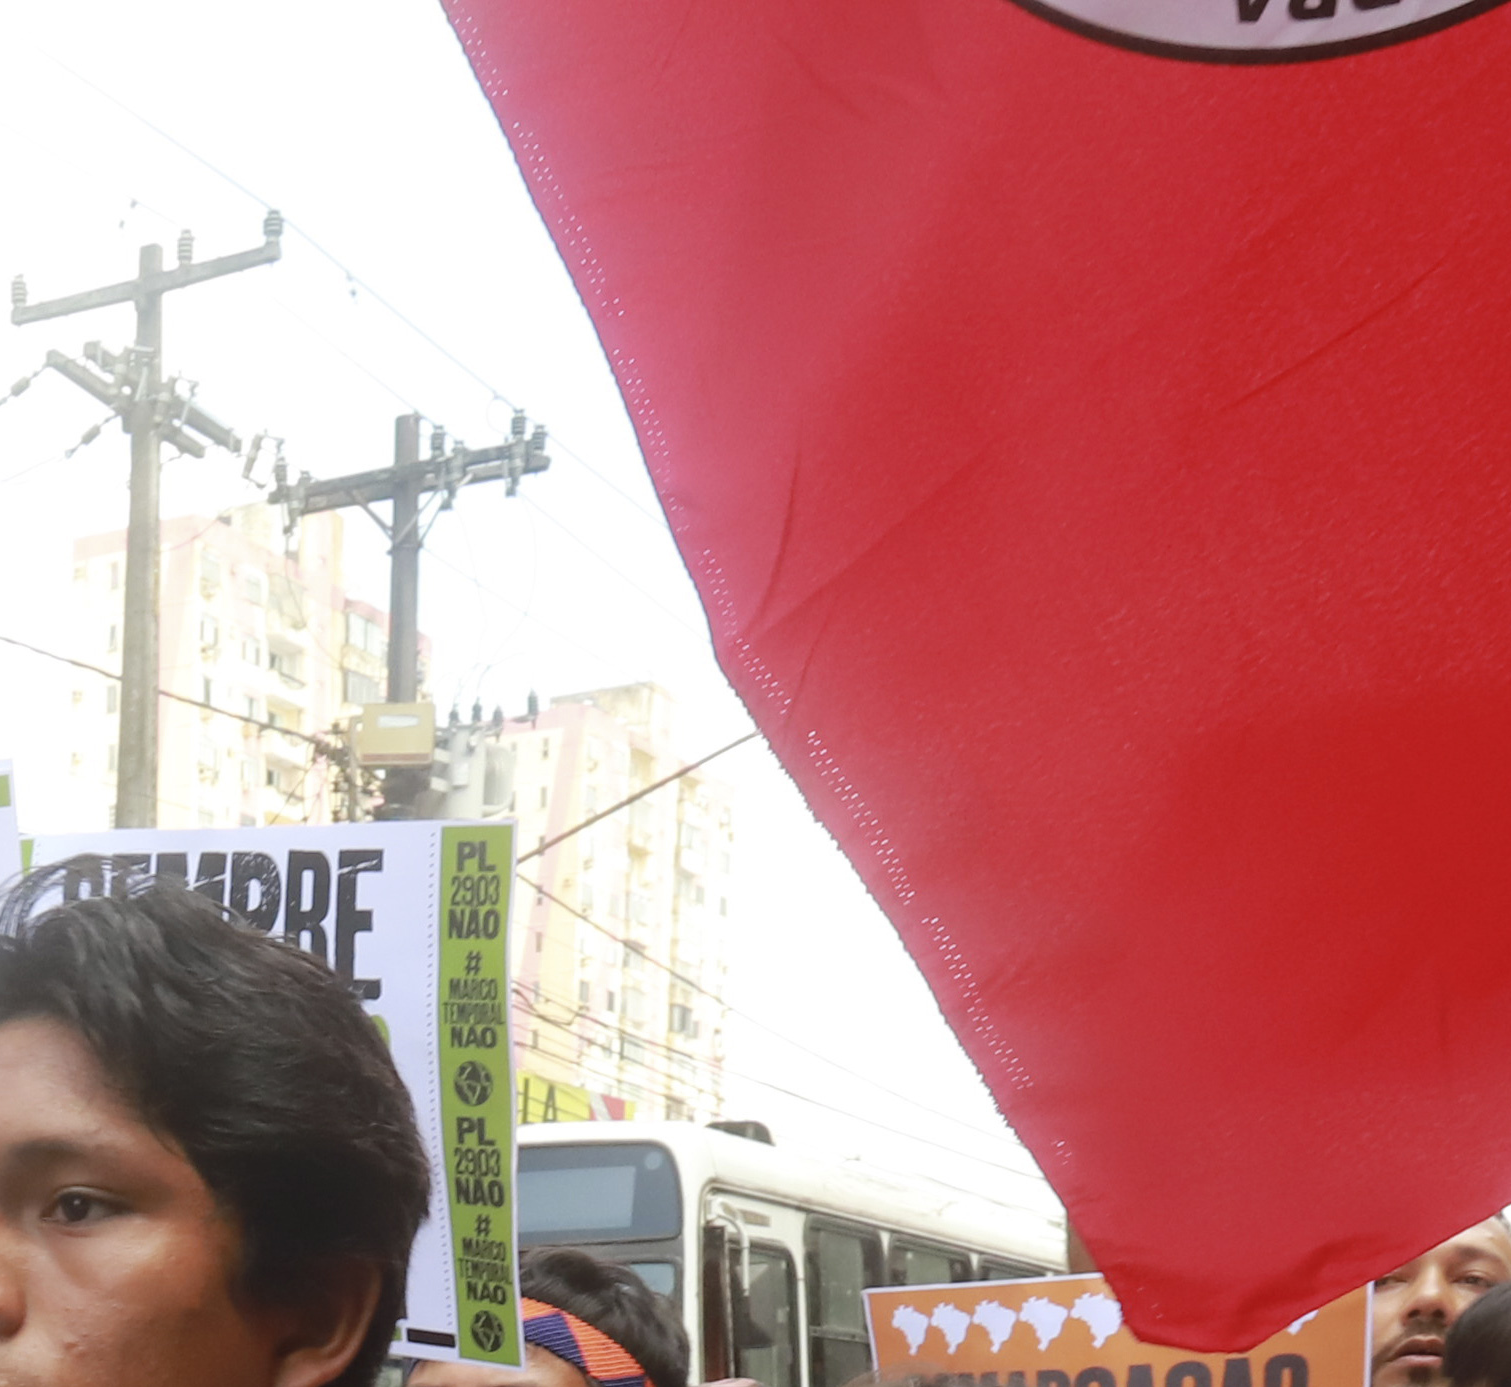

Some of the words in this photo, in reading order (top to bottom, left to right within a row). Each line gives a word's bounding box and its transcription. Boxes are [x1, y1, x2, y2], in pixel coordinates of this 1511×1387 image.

[456, 841, 496, 872] PL
[450, 875, 501, 906] 2903
[63, 848, 385, 1001] PRE
[448, 978, 498, 1001] MARCO
[442, 1002, 505, 1025] TEMPORAL
[456, 1116, 496, 1146] PL
[453, 1147, 501, 1178] 2903
[462, 1237, 506, 1262] MARCO
[458, 1256, 512, 1285] TEMPORAL
